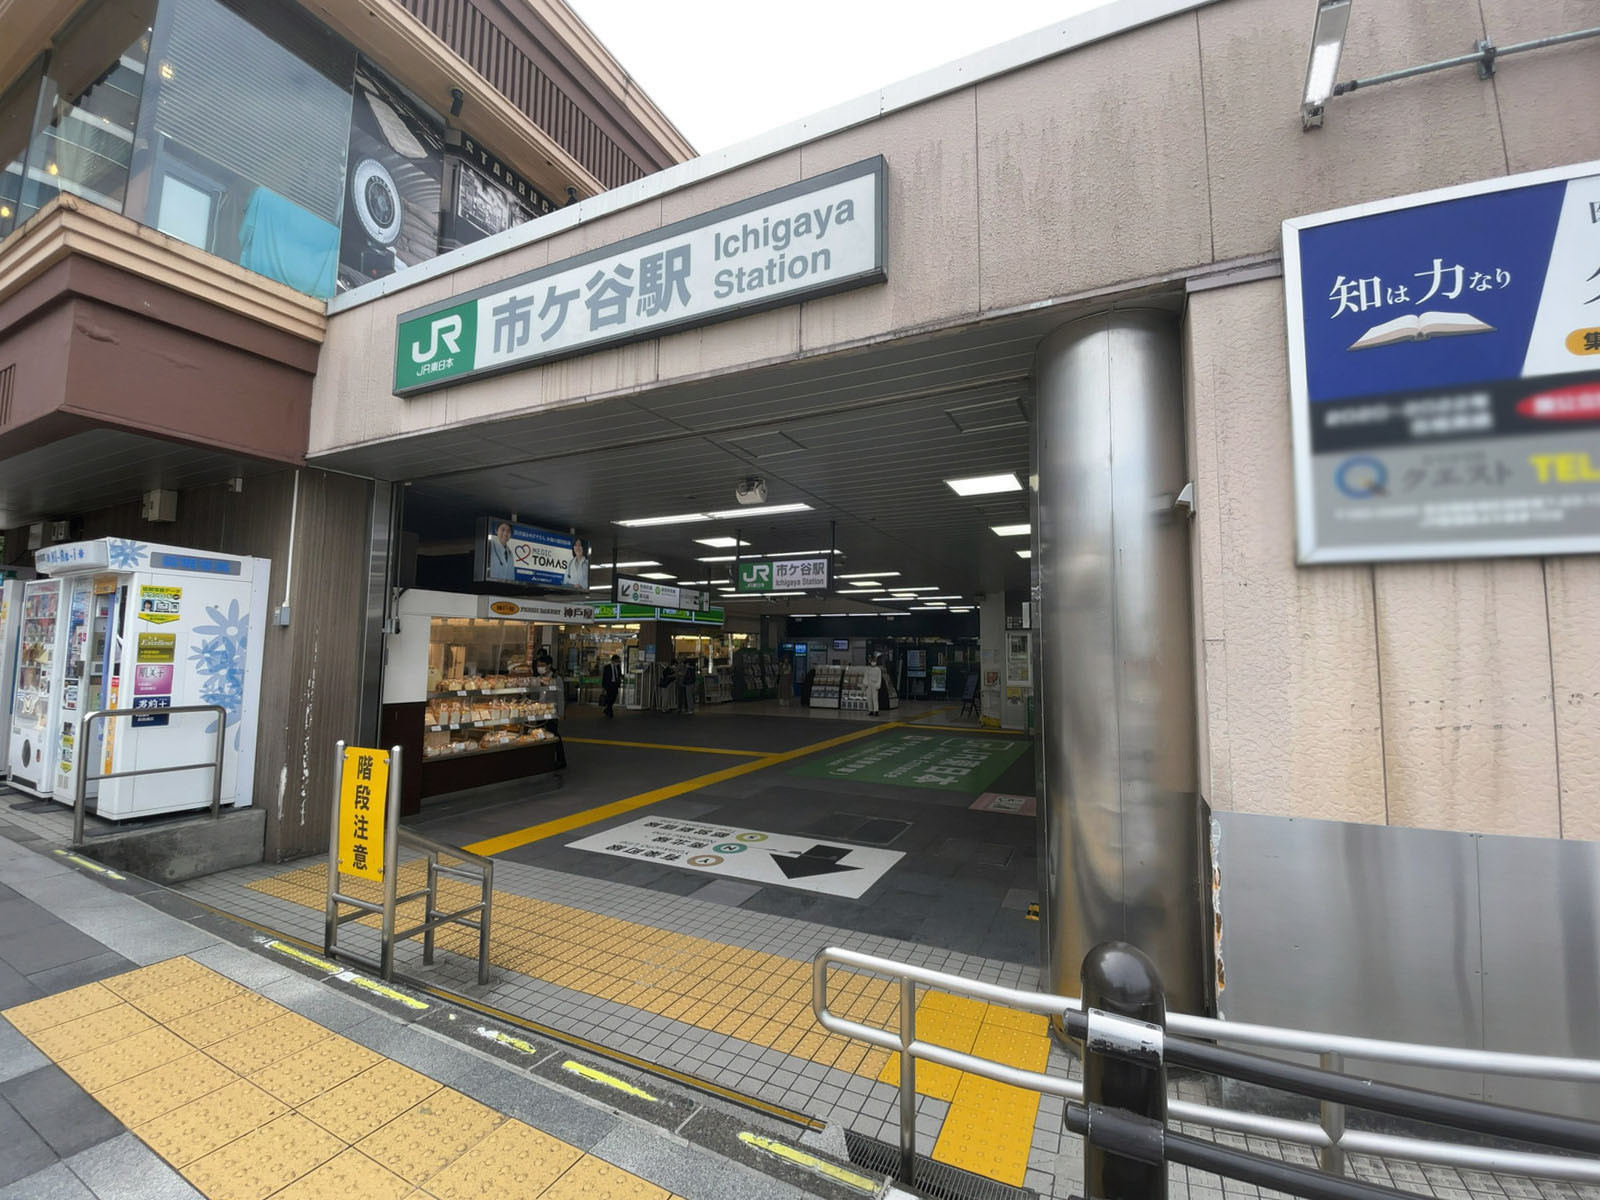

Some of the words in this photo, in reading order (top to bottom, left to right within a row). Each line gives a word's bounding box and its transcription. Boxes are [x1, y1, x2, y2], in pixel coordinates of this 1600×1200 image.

[713, 198, 855, 262] Ichigaya
[713, 247, 832, 300] Station
[1328, 258, 1512, 319] 知は力なり
[491, 243, 693, 355] 市ケ谷駅
[411, 314, 463, 363] JR
[415, 357, 455, 377] JR東日本
[532, 555, 568, 570] TOMAS
[742, 565, 770, 583] JR
[775, 578, 801, 588] Ichigaya
[802, 577, 825, 586] Station
[140, 639, 174, 648] Excellent
[352, 755, 374, 871] 階段注意
